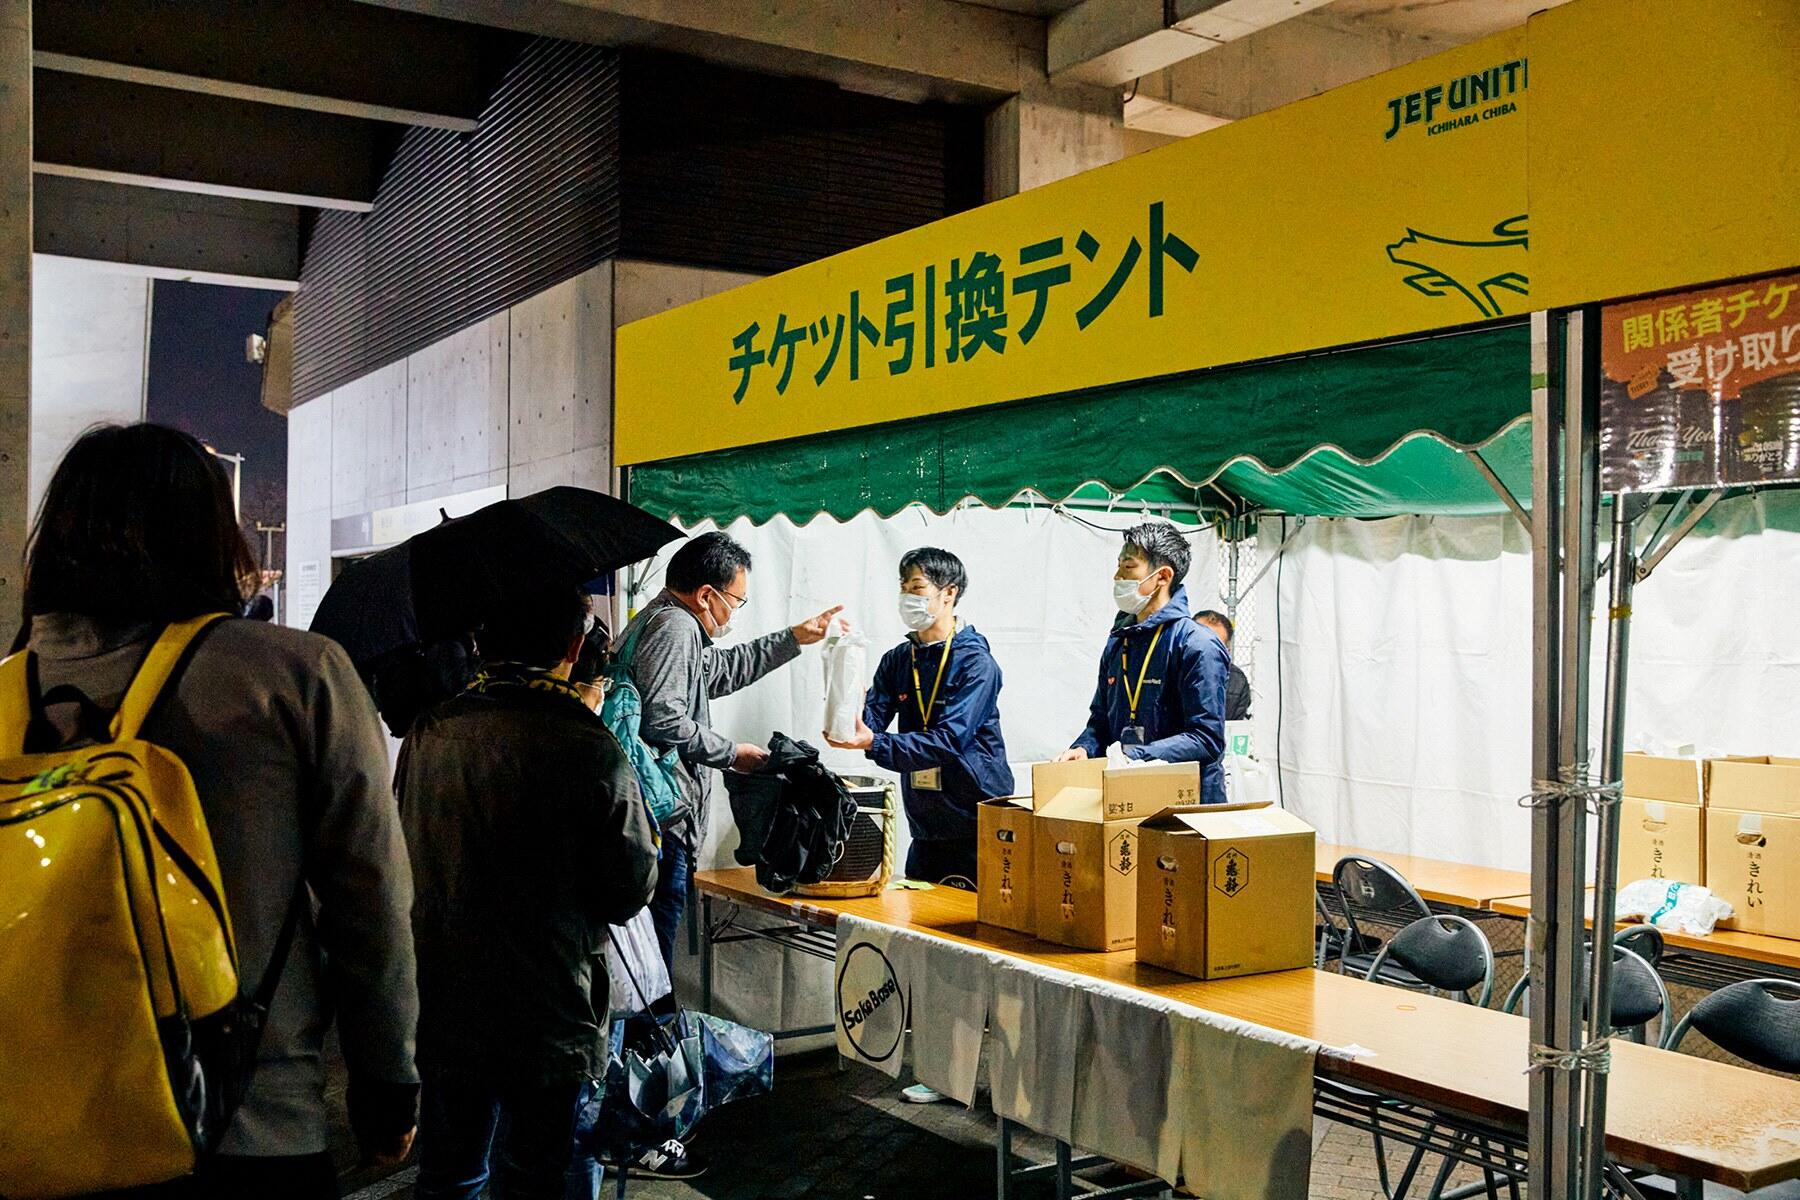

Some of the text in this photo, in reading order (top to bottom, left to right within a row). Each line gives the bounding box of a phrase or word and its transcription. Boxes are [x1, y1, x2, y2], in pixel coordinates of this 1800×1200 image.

[1384, 79, 1444, 142] JEF
[1427, 101, 1518, 137] ICHIHARA CHIBA
[728, 201, 1200, 405] チケット引換テント
[1621, 283, 1799, 354] 関係者チケ
[1626, 426, 1679, 451] Tha
[1747, 861, 1764, 908] きれい
